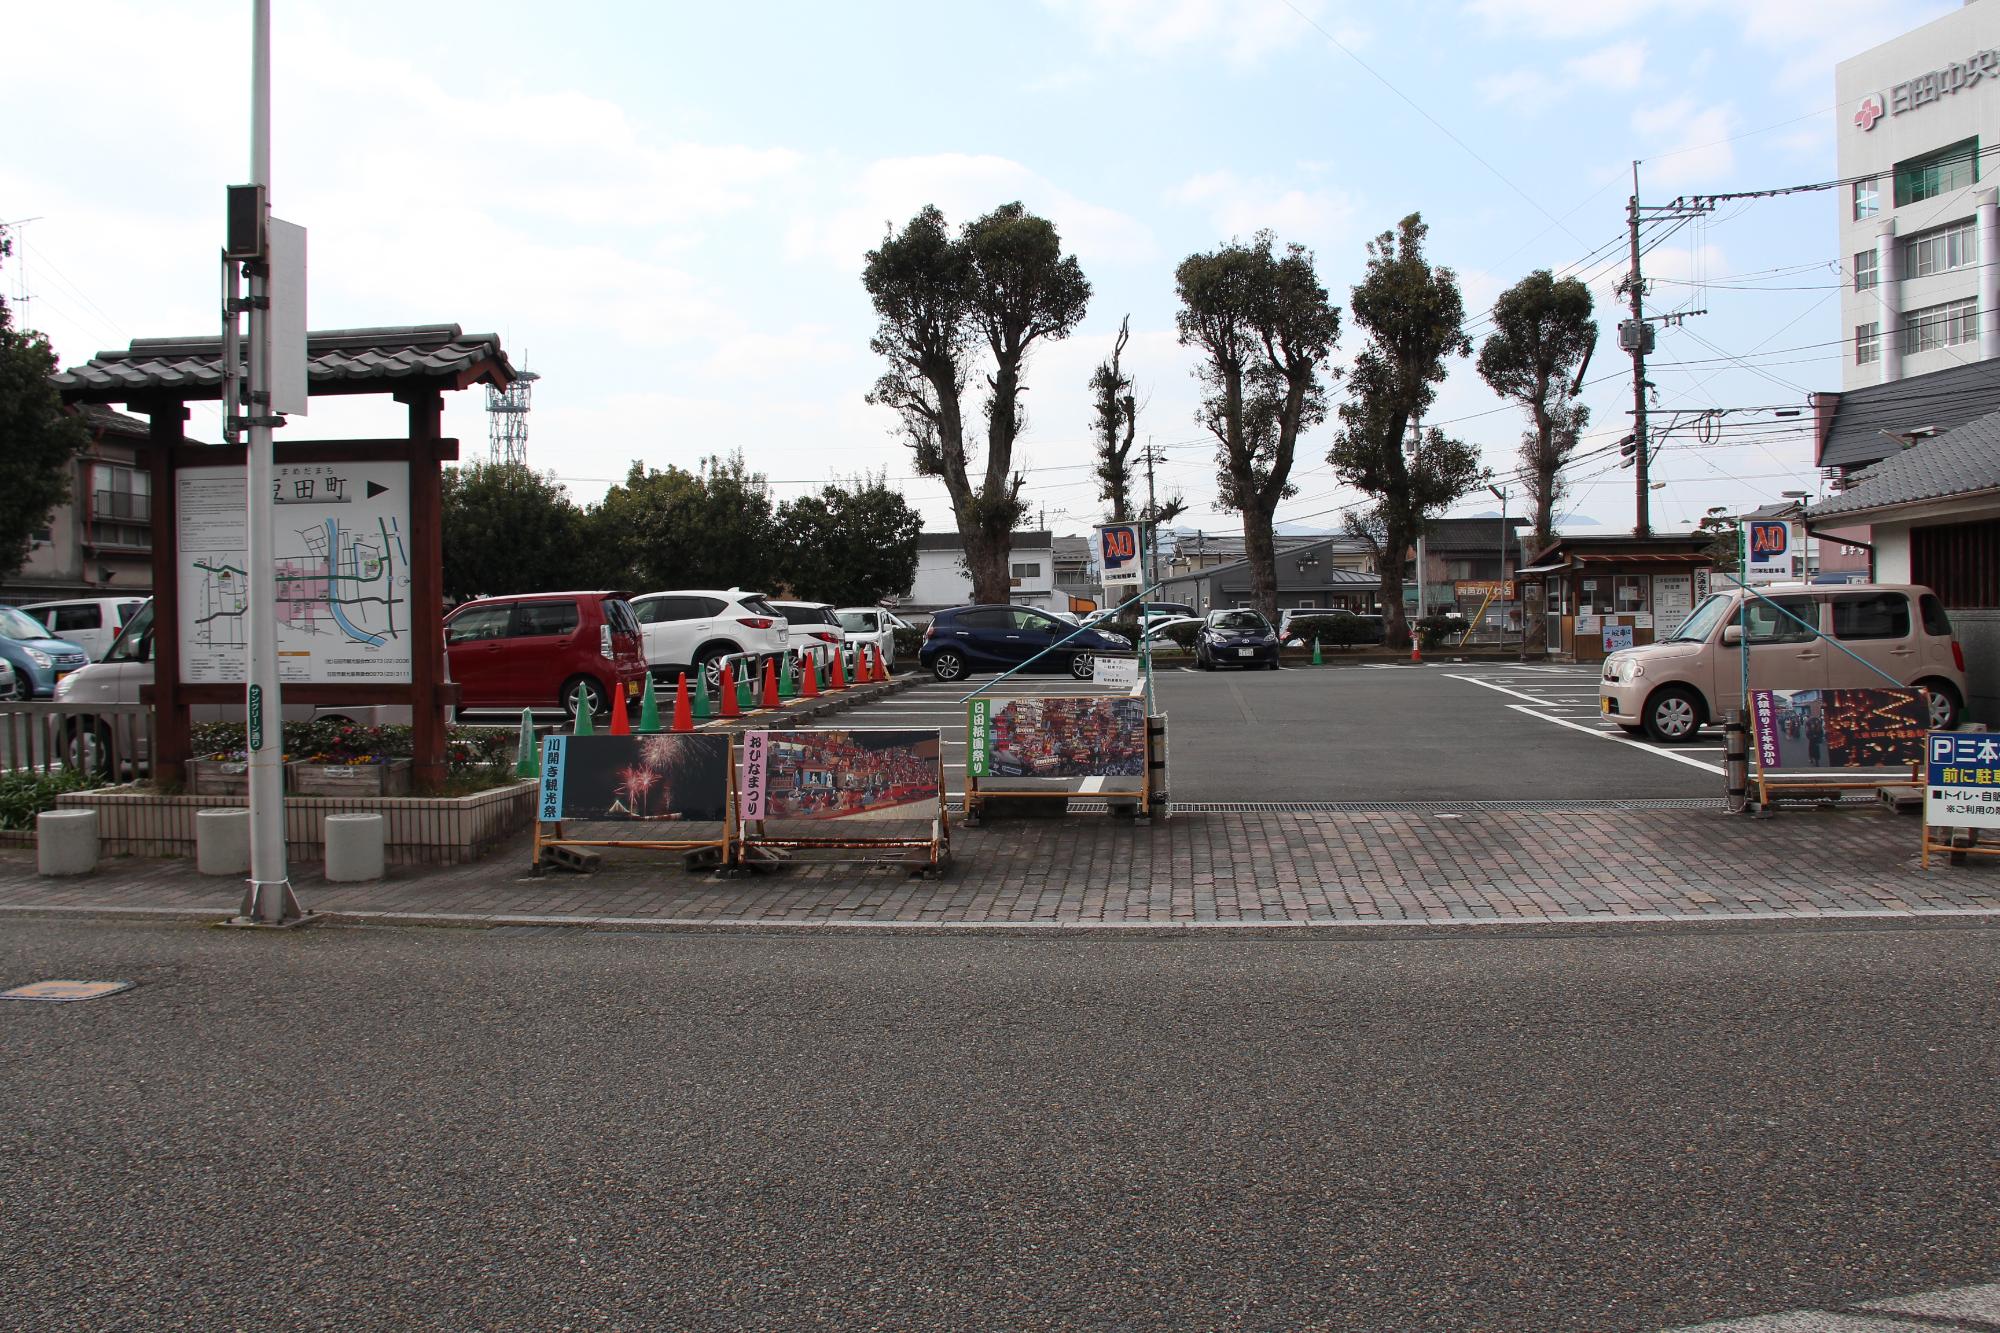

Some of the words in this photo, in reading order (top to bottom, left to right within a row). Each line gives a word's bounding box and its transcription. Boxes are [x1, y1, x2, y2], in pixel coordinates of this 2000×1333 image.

[1890, 50, 2000, 116] 日田中央
[281, 466, 334, 475] まめだまち
[543, 738, 561, 818] 川開き観光祭
[747, 736, 762, 815] おひなまつり
[1956, 739, 2000, 764] 三本
